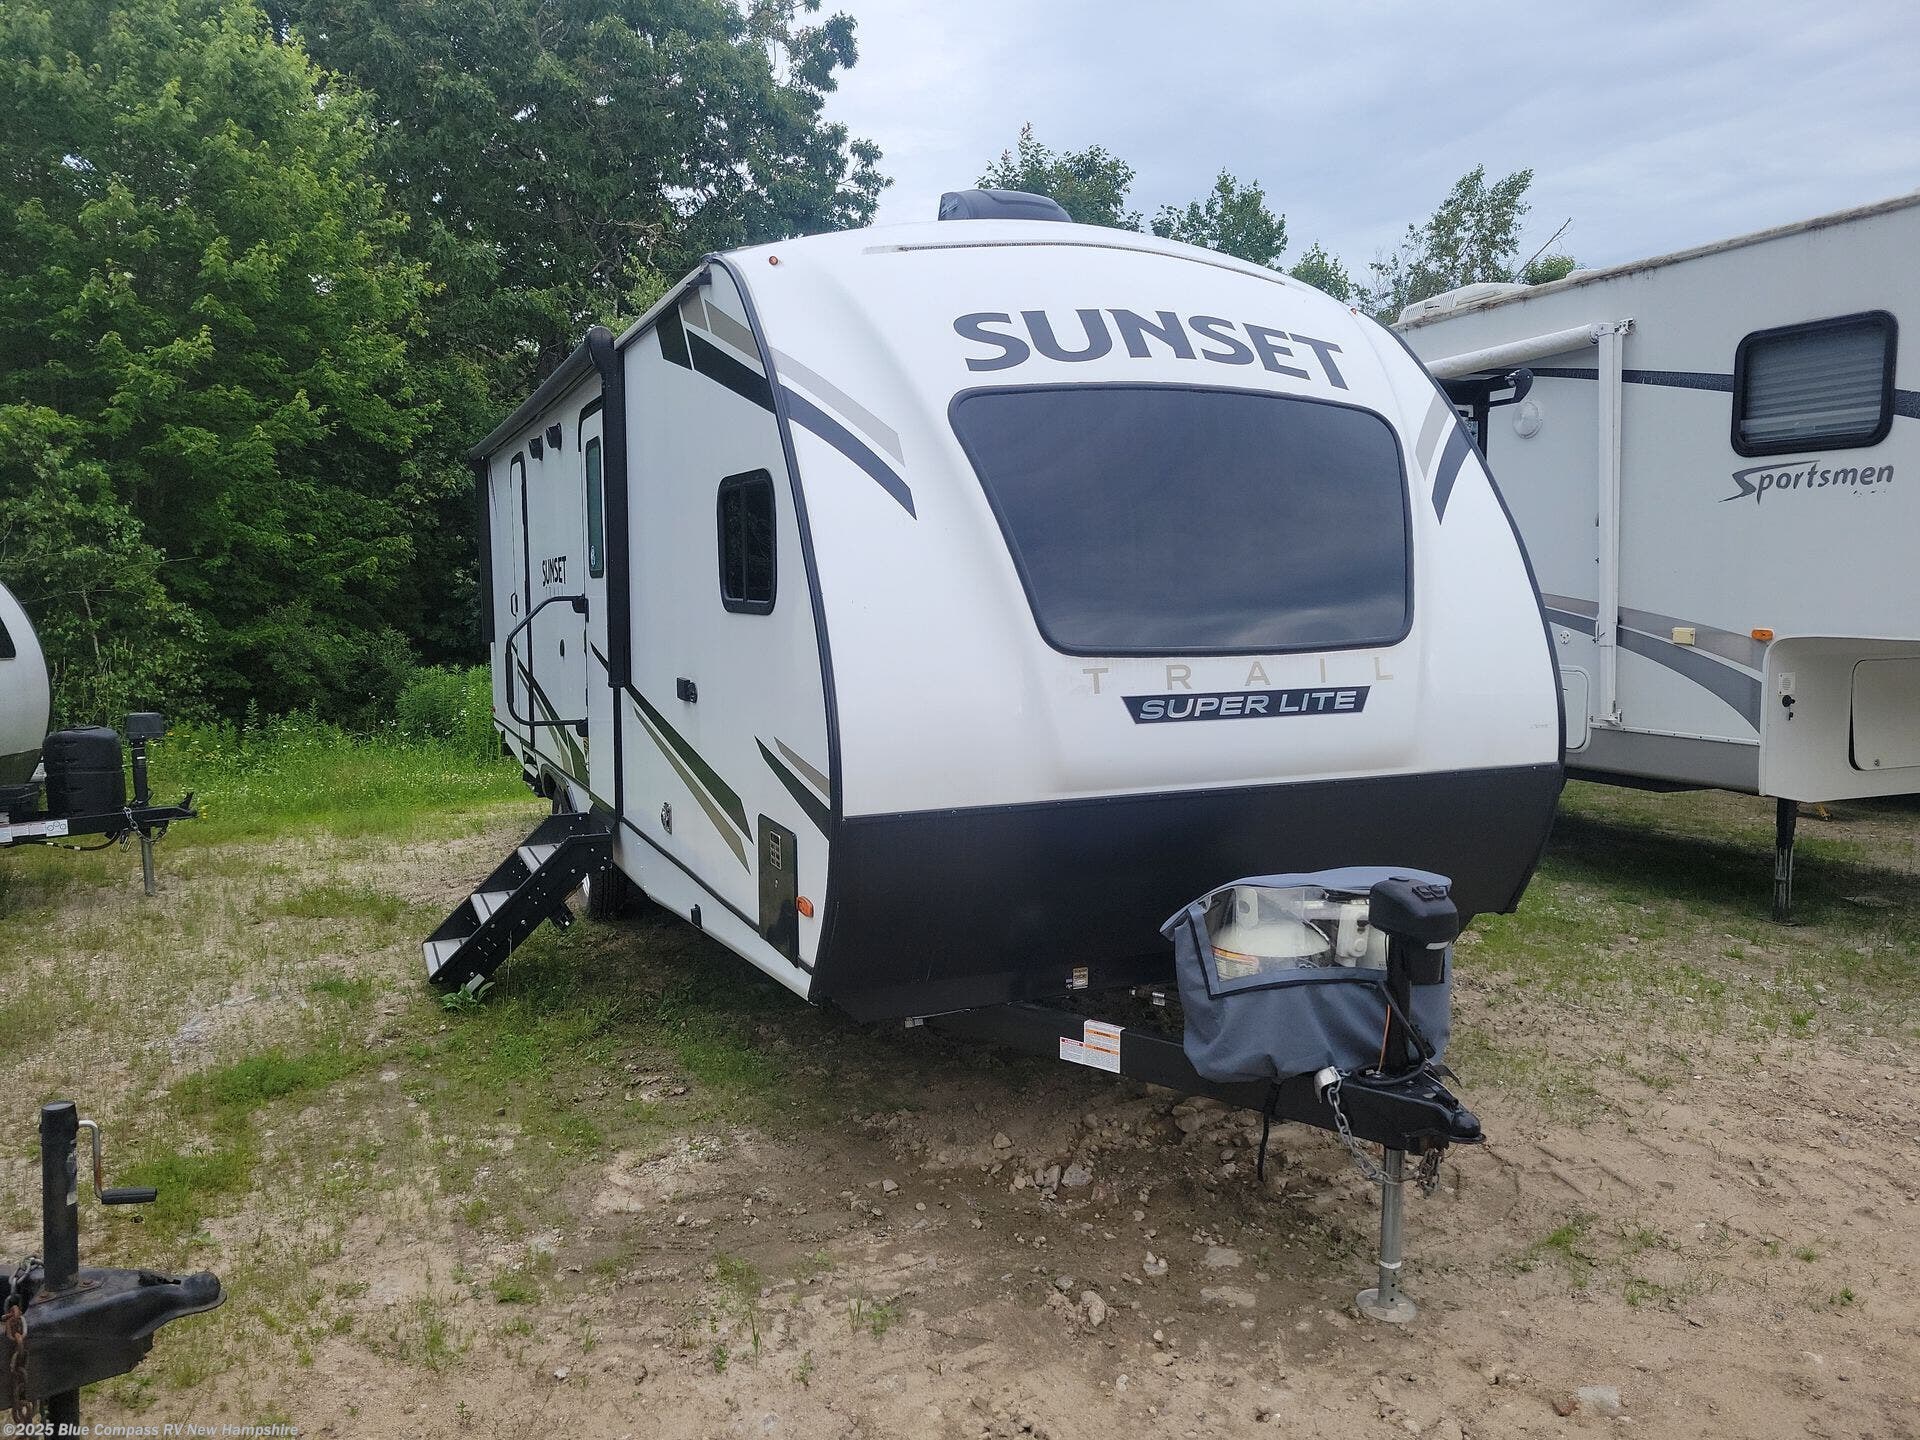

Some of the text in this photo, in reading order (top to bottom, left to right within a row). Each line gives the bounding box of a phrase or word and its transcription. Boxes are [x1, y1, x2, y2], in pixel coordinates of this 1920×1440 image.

[953, 309, 1349, 391] SUNSET
[1718, 459, 1895, 505] Sportsmen
[541, 555, 567, 588] SUNSET
[1082, 656, 1394, 695] TRAIL
[1139, 690, 1357, 721] SUPER LITE
